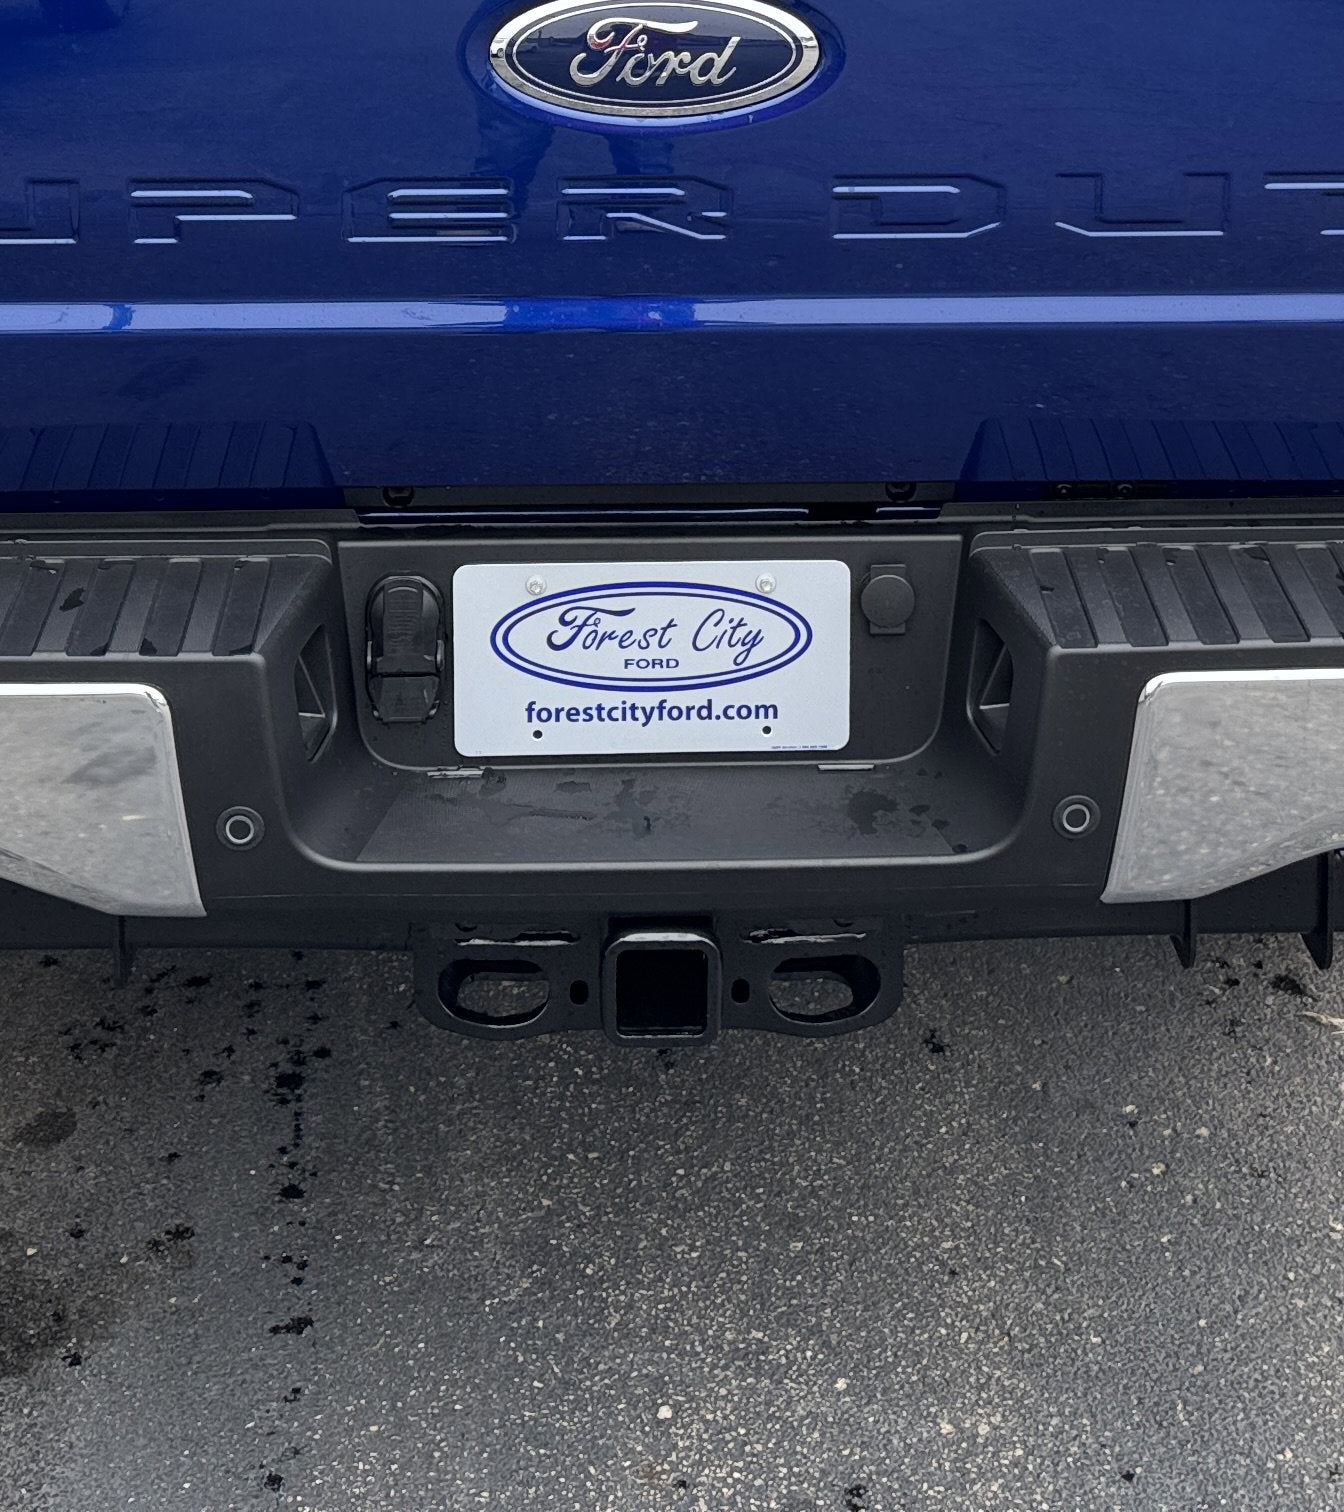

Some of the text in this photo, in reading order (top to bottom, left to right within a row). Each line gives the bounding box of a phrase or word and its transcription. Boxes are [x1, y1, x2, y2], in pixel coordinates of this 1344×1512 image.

[570, 18, 741, 86] Ford
[546, 606, 765, 666] Forest City
[623, 658, 680, 670] FORD
[525, 698, 779, 727] forestcityford.com
